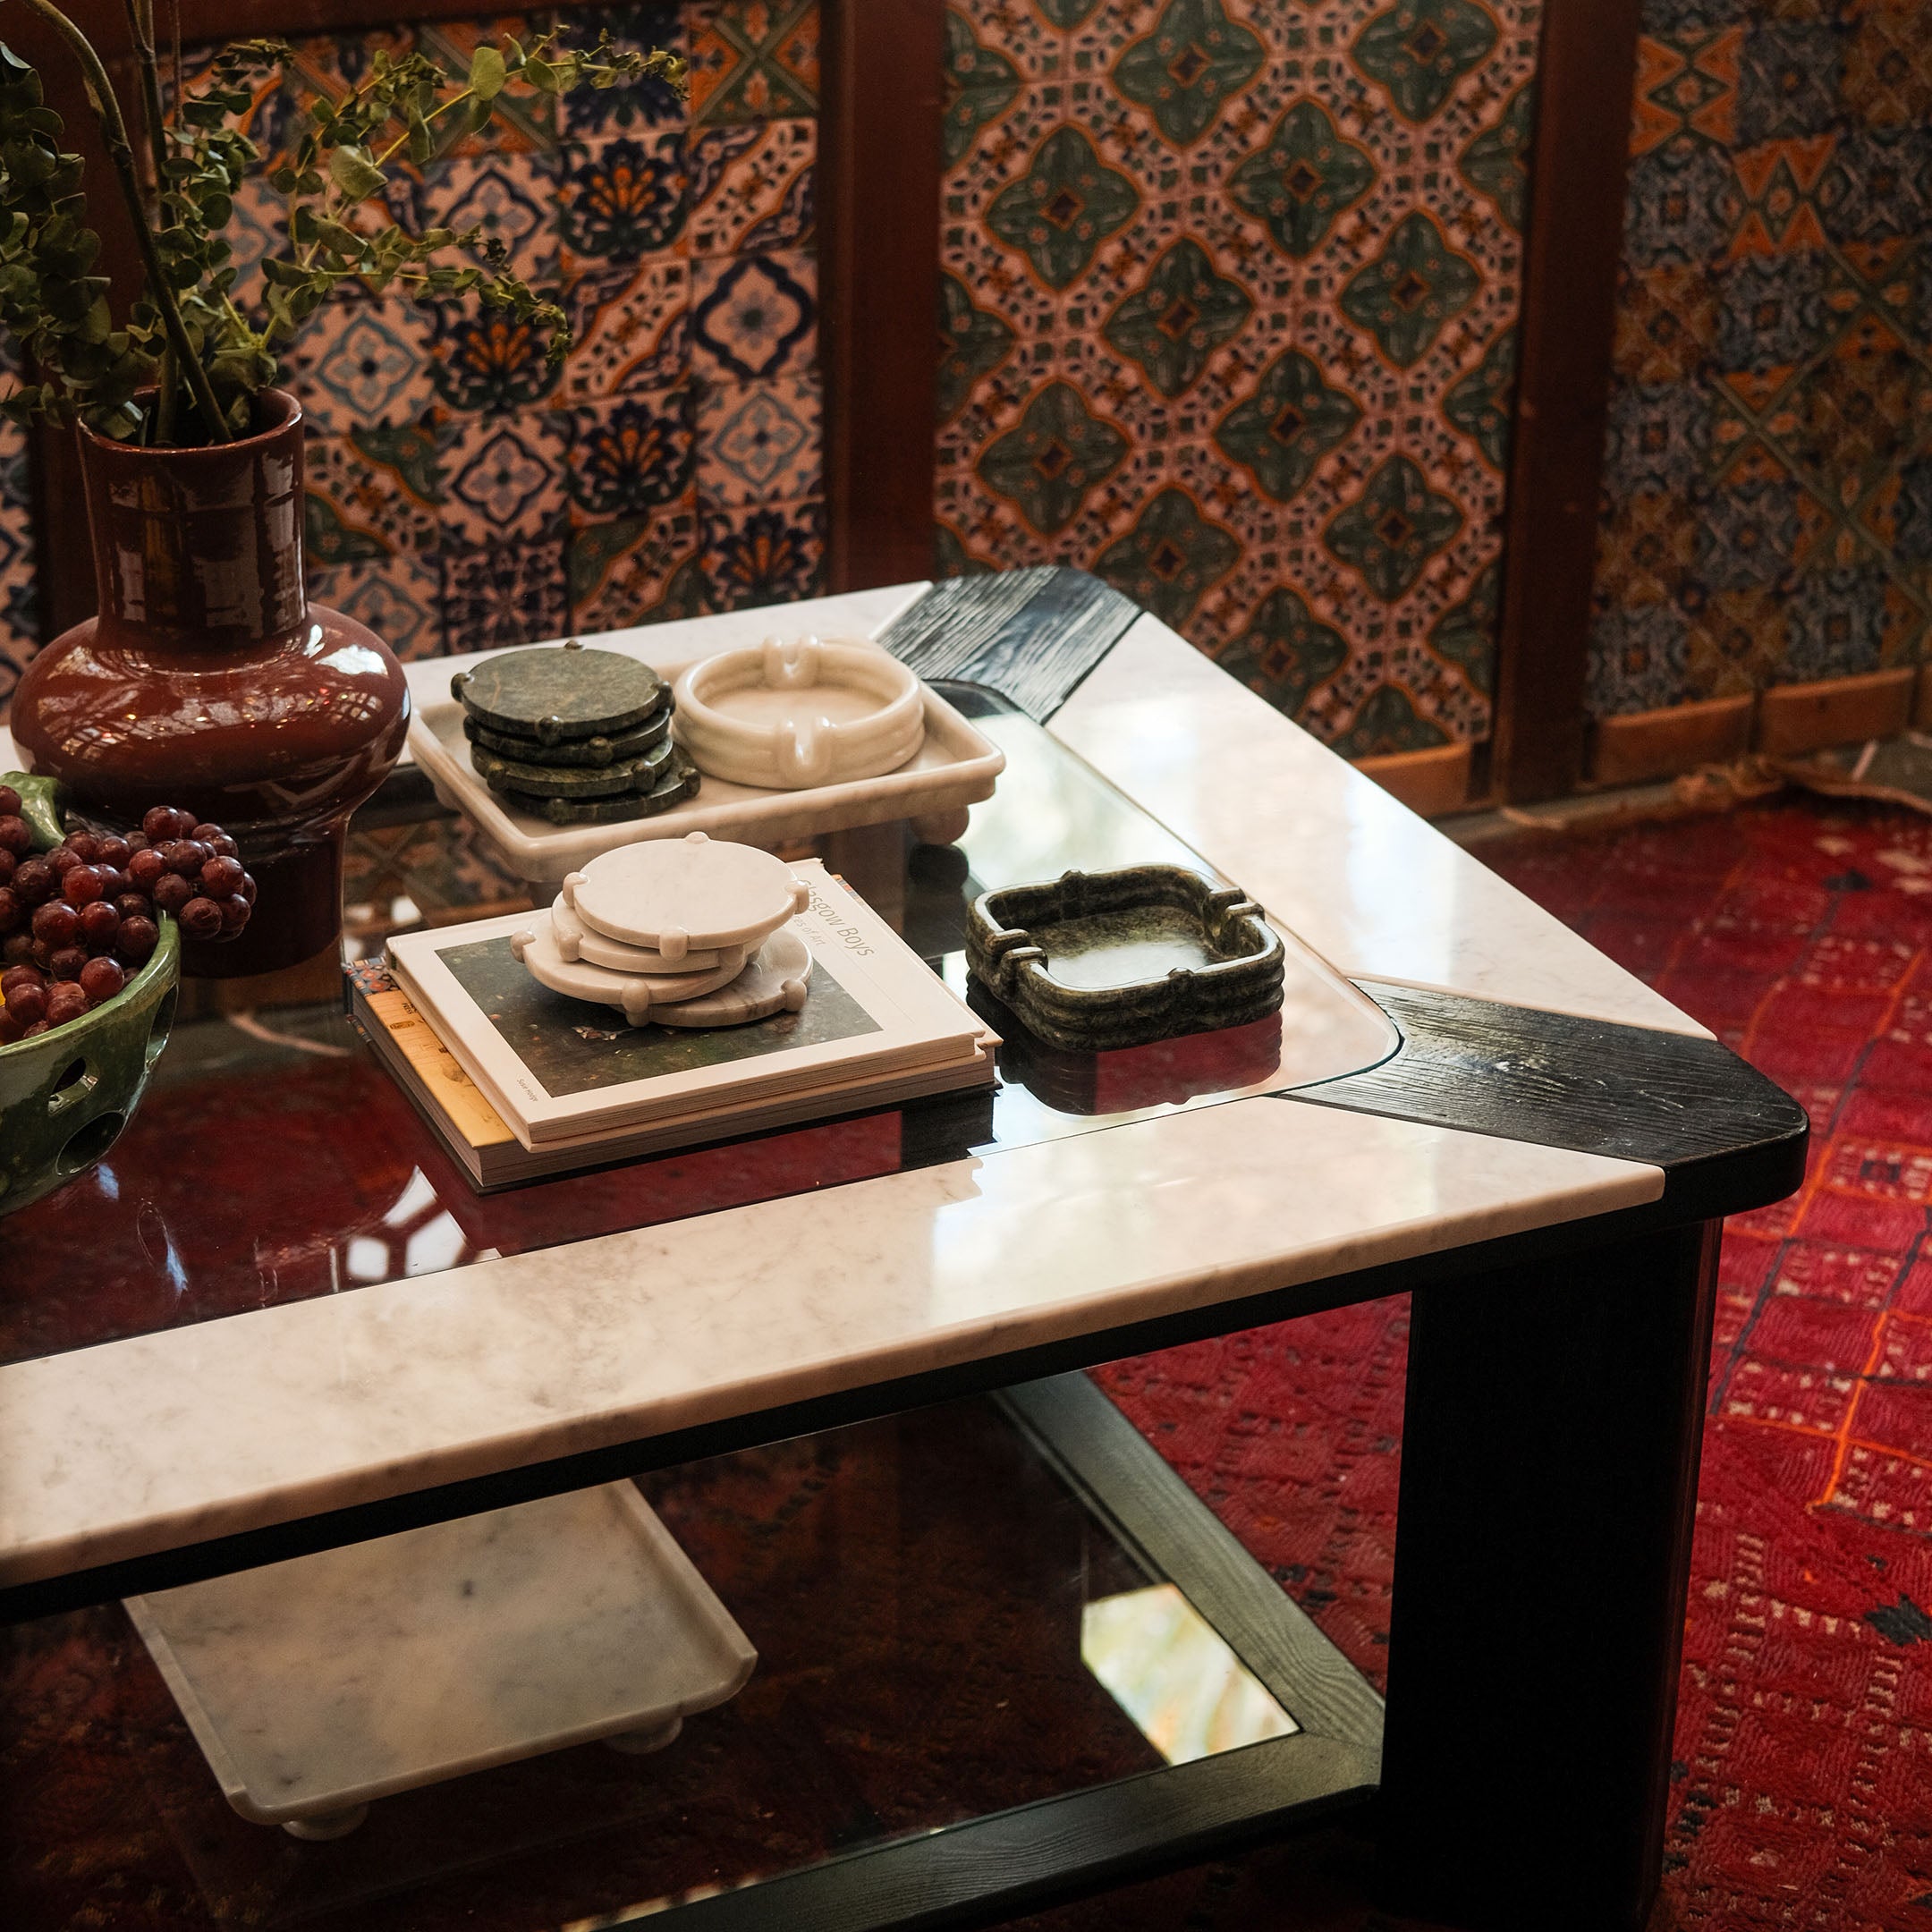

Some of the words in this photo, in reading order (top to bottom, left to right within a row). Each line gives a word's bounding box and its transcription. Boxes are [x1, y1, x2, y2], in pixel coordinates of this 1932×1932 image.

[801, 880, 845, 926] asgow
[837, 928, 874, 956] Boys
[809, 936, 826, 946] Art
